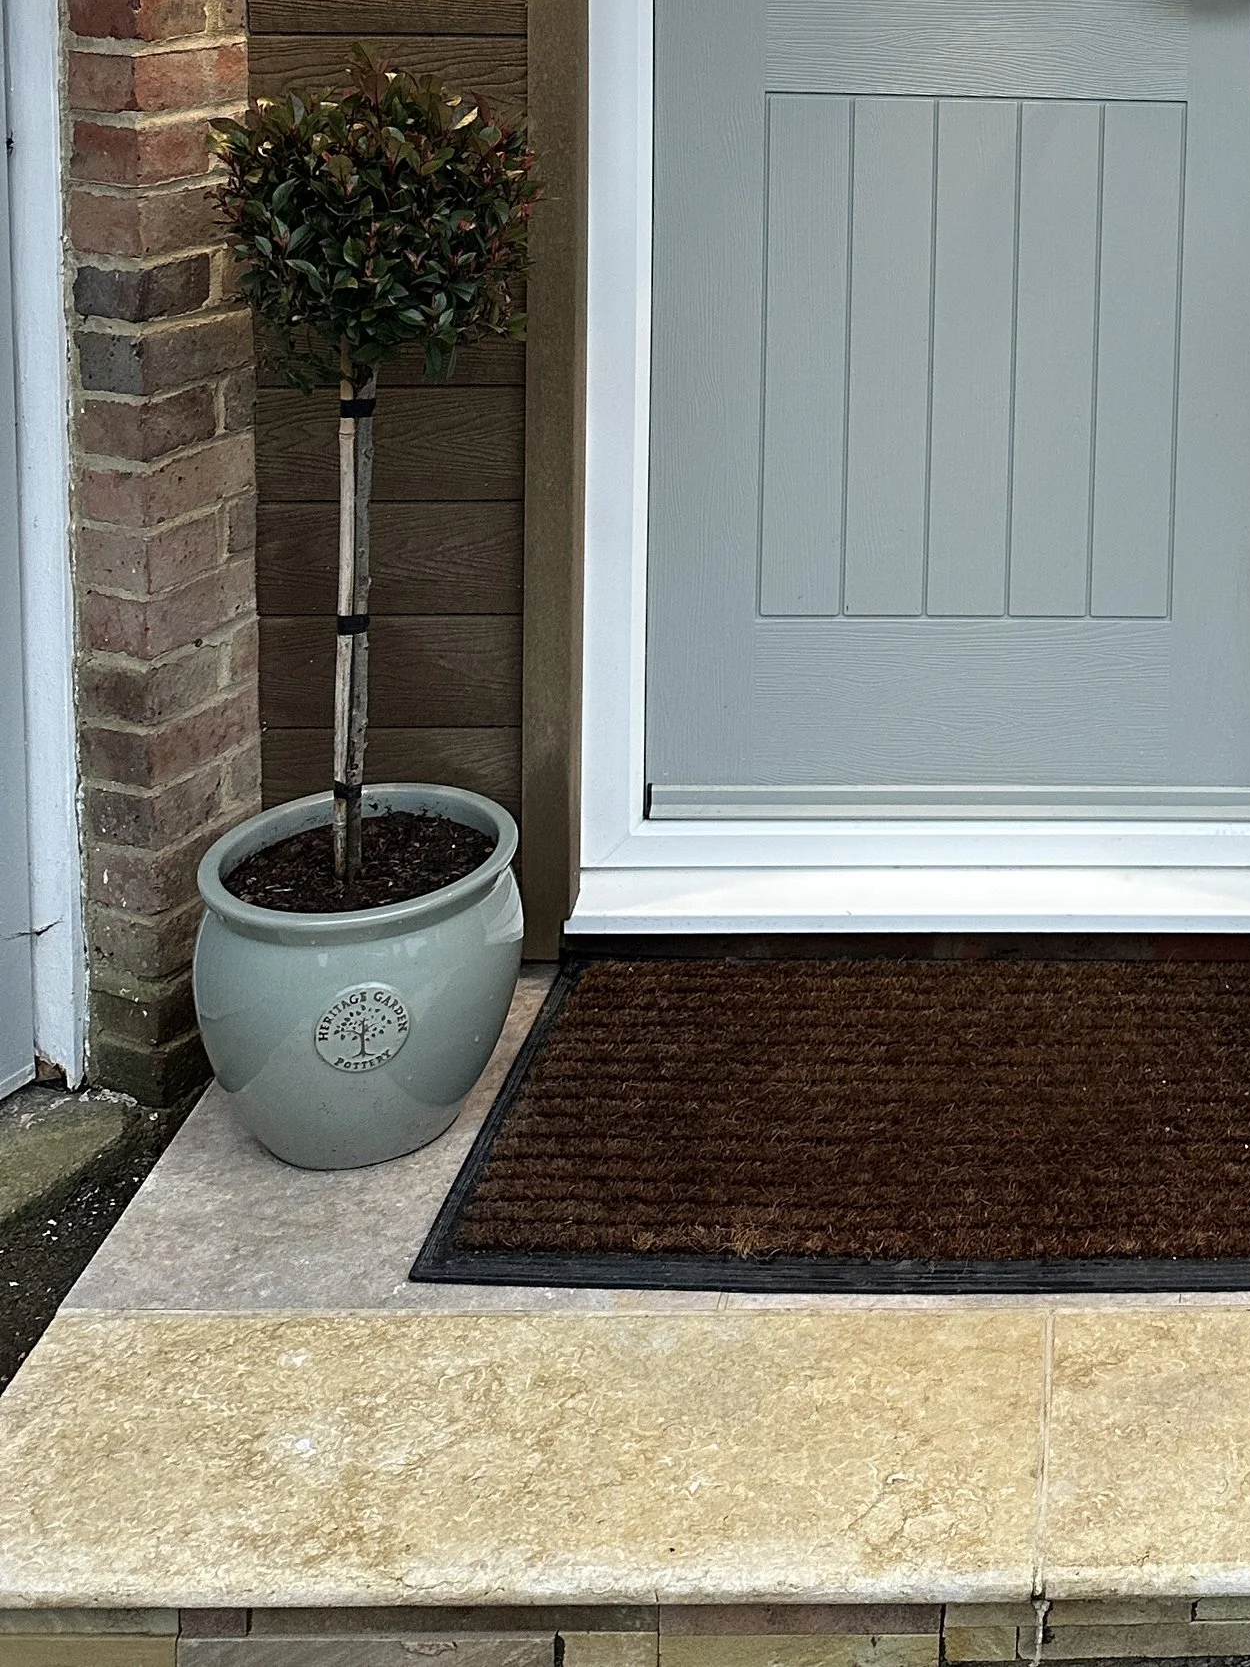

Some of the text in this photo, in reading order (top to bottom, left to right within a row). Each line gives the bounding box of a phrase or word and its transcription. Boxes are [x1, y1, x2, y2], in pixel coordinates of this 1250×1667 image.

[318, 991, 408, 1042] HERITAGE GARDEN
[333, 1049, 392, 1070] POTTERY
